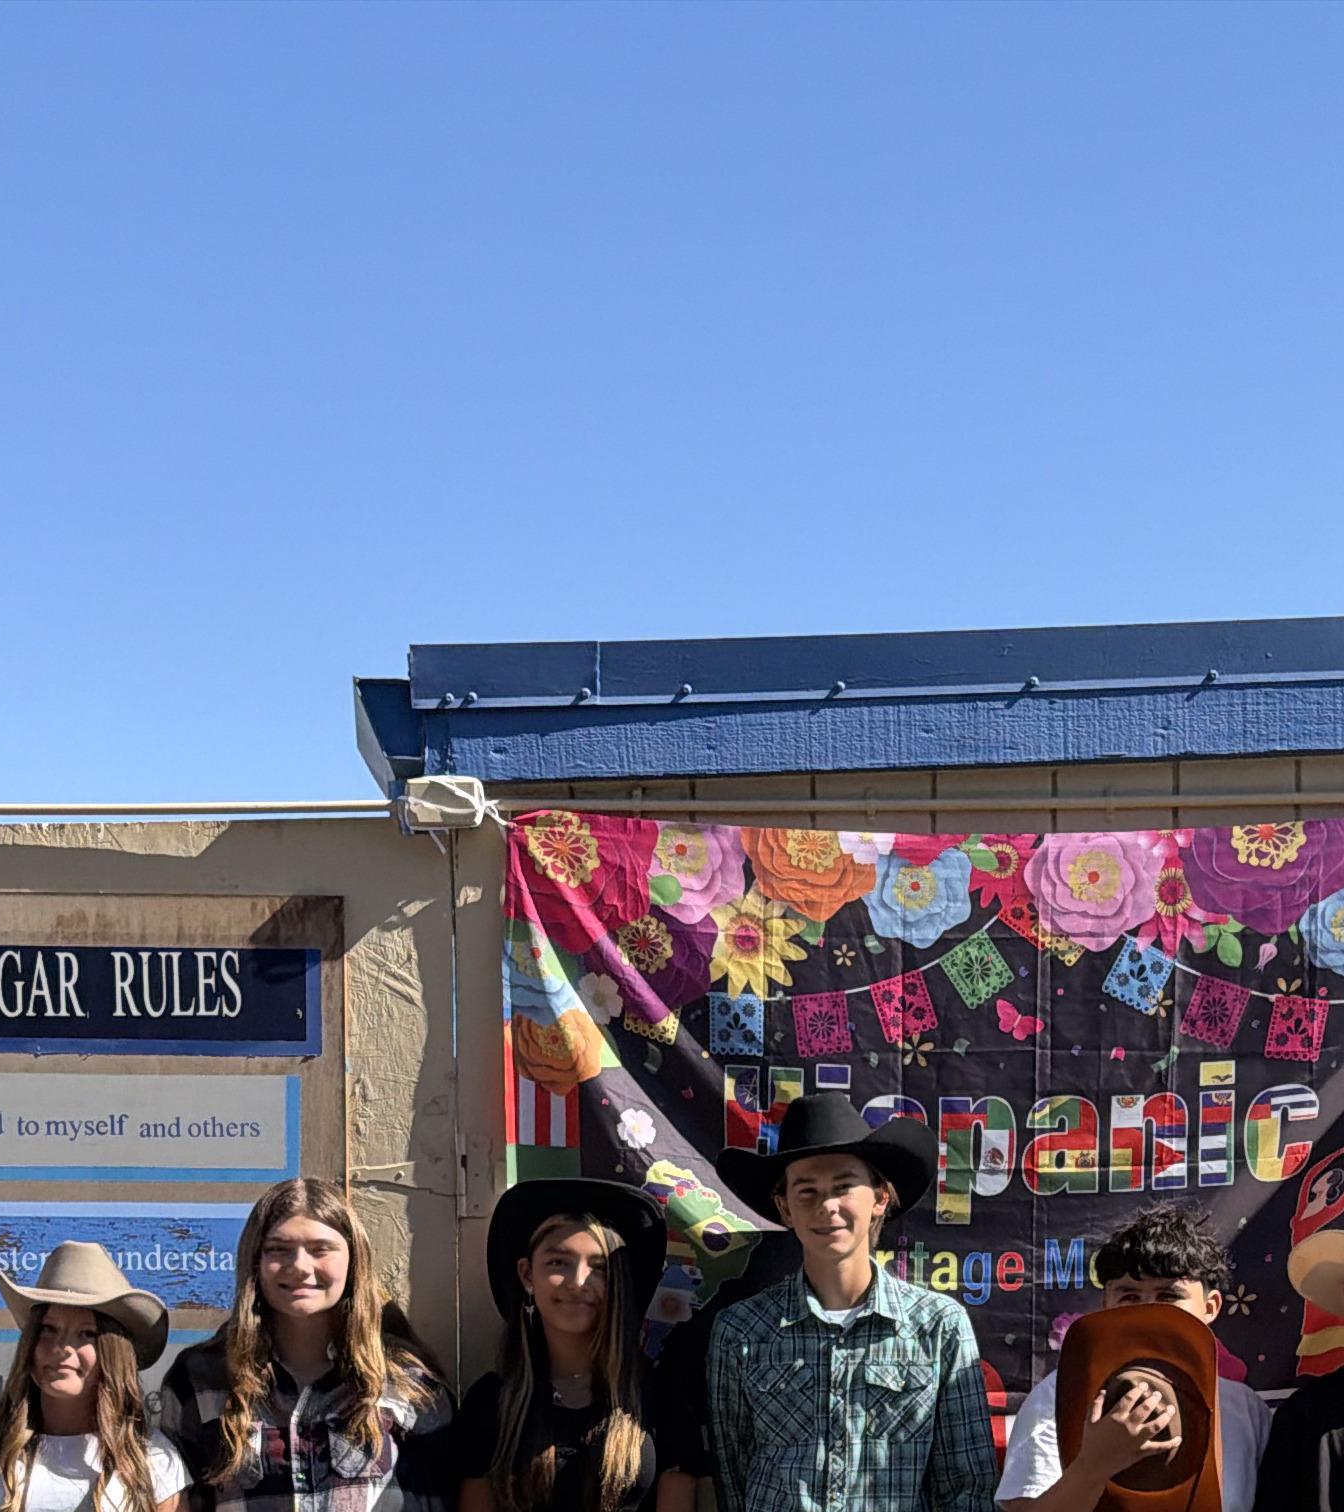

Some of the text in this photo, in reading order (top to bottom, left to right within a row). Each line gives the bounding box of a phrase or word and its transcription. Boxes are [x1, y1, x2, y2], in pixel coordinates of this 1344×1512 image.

[110, 950, 242, 1019] RULES
[17, 1118, 39, 1136] to
[46, 1113, 129, 1141] myself
[139, 1116, 181, 1139] and
[187, 1115, 261, 1139] others
[725, 1060, 1320, 1225] Hpanic
[109, 1243, 237, 1272] understa
[876, 1235, 1025, 1306] ritage
